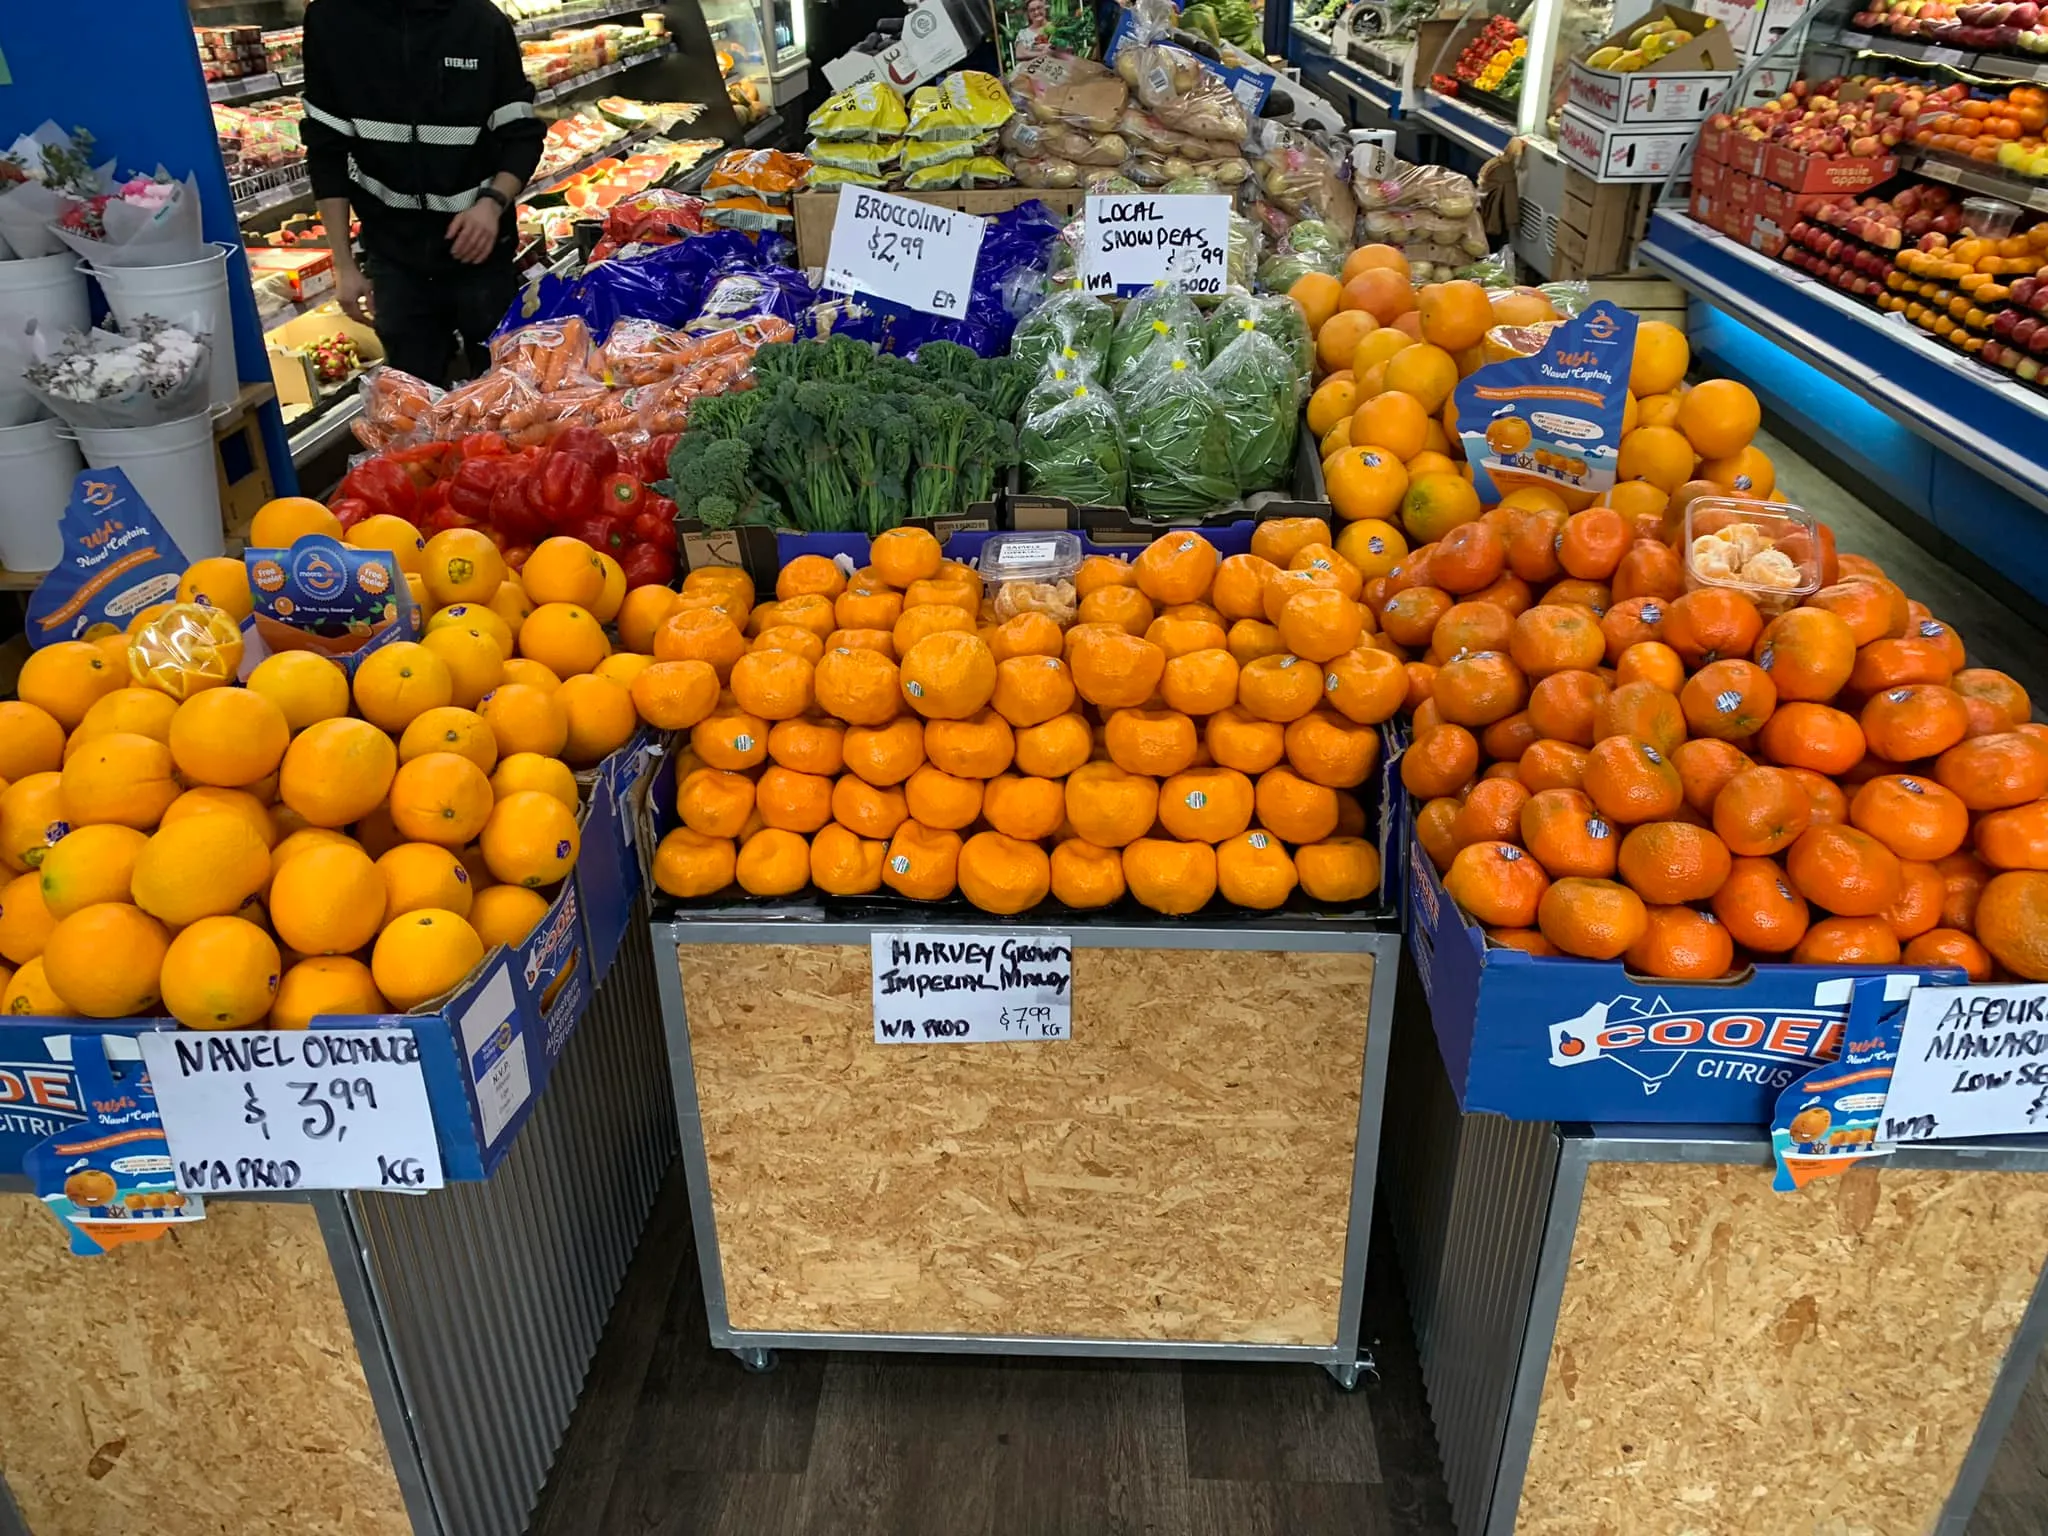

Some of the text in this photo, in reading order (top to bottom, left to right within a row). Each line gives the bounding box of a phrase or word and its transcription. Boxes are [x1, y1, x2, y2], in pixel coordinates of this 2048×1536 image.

[1826, 165, 1870, 176] missile
[1832, 175, 1873, 185] apples
[1098, 199, 1164, 224] LOCAL
[1087, 272, 1113, 291] WA
[1540, 364, 1613, 385] Navel Captain
[76, 525, 150, 568] Navel Captain
[892, 939, 996, 973] HARVEY
[881, 1018, 970, 1039] WA PROD
[1041, 1023, 1063, 1036] KG
[174, 1035, 295, 1077] NAVEL
[1696, 1058, 1793, 1088] CITRUS
[1951, 1062, 2048, 1093] LOW SE
[98, 1113, 130, 1125] Navel
[377, 1154, 425, 1186] KG
